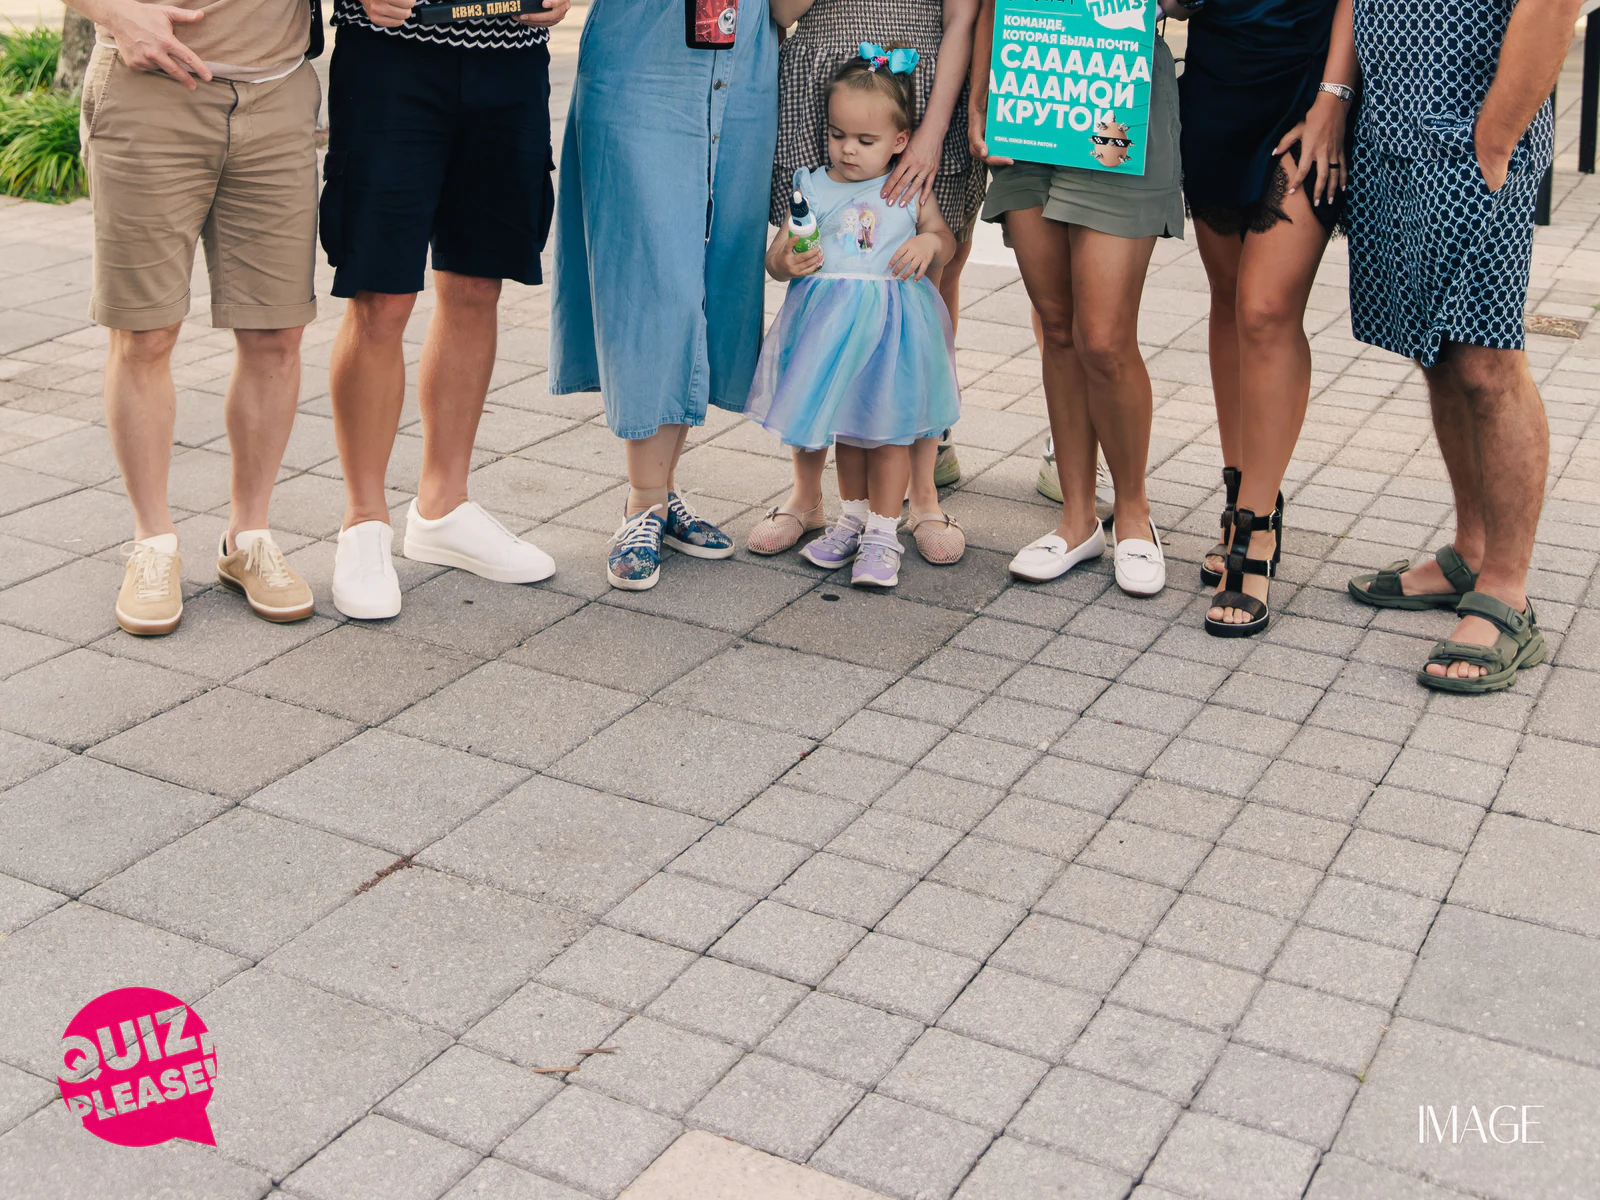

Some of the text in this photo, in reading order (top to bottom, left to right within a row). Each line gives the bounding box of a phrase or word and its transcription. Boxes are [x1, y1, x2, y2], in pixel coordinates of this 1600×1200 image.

[451, 0, 521, 19] КВИЗ, ПЛИЗ!
[1003, 14, 1066, 32] КОМАНДЕ,
[1002, 29, 1139, 52] КОТОРАЯ БЫЛА ПОЧТИ
[1000, 43, 1150, 82] САААААА
